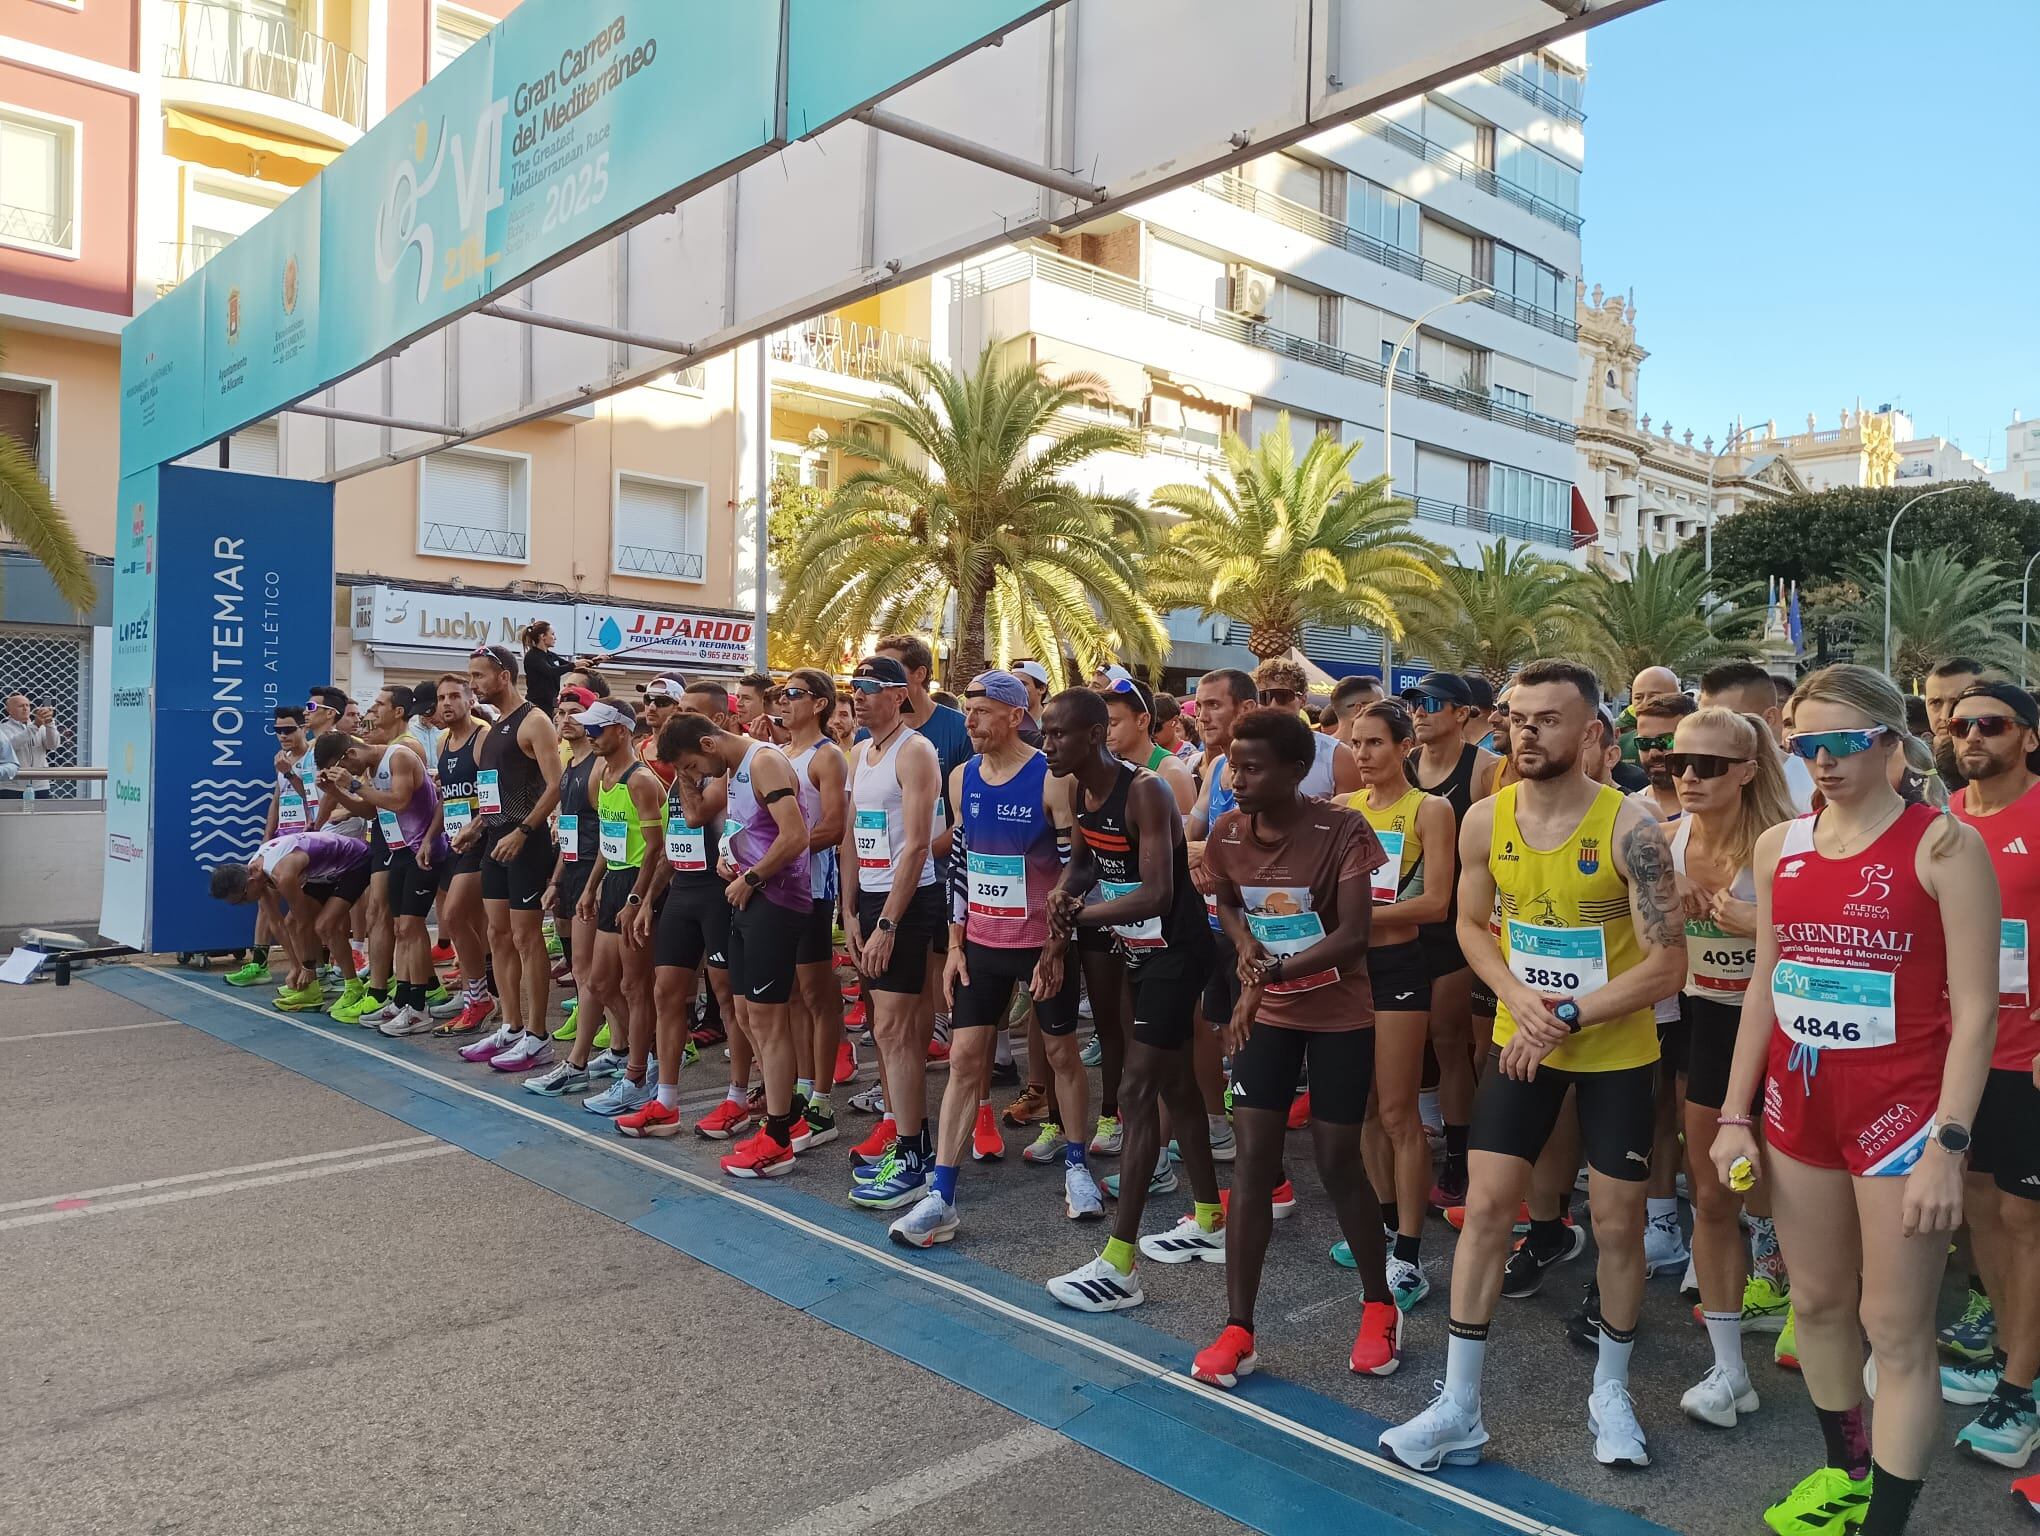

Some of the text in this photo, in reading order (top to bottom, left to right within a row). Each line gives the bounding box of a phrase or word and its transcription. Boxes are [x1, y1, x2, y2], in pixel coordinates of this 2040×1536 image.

[514, 15, 626, 118] Gran Carrera
[512, 38, 658, 158] del Mediterráneo
[451, 95, 509, 232] VI
[509, 124, 611, 201] Mediterranean Race
[511, 127, 575, 180] The Greatest
[542, 151, 610, 236] 2025
[218, 356, 248, 383] Ayuntamiento
[221, 374, 245, 395] de Alicante
[418, 609, 492, 647] Lucky
[626, 614, 753, 643] J.PARDO
[211, 536, 246, 767] MONTEMAR
[261, 570, 281, 737] CLUB ATLÉTICO
[629, 635, 688, 648] FONTANERÍA
[699, 641, 747, 651] REFORMAS
[115, 780, 141, 806] Coplaca
[670, 842, 693, 854] 3908
[977, 883, 1009, 898] 2367
[1843, 903, 1890, 915] ATLETICA
[1525, 933, 1539, 948] VI
[1788, 922, 1914, 953] GENERALI
[1803, 944, 1841, 956] Generale
[1843, 948, 1853, 957] di
[1816, 956, 1845, 966] Federica
[1846, 959, 1871, 968] Alasia
[1524, 966, 1580, 990] 3830
[1794, 971, 1810, 991] VI
[1793, 1015, 1861, 1042] 4846
[1856, 1103, 1910, 1150] ATLETICA
